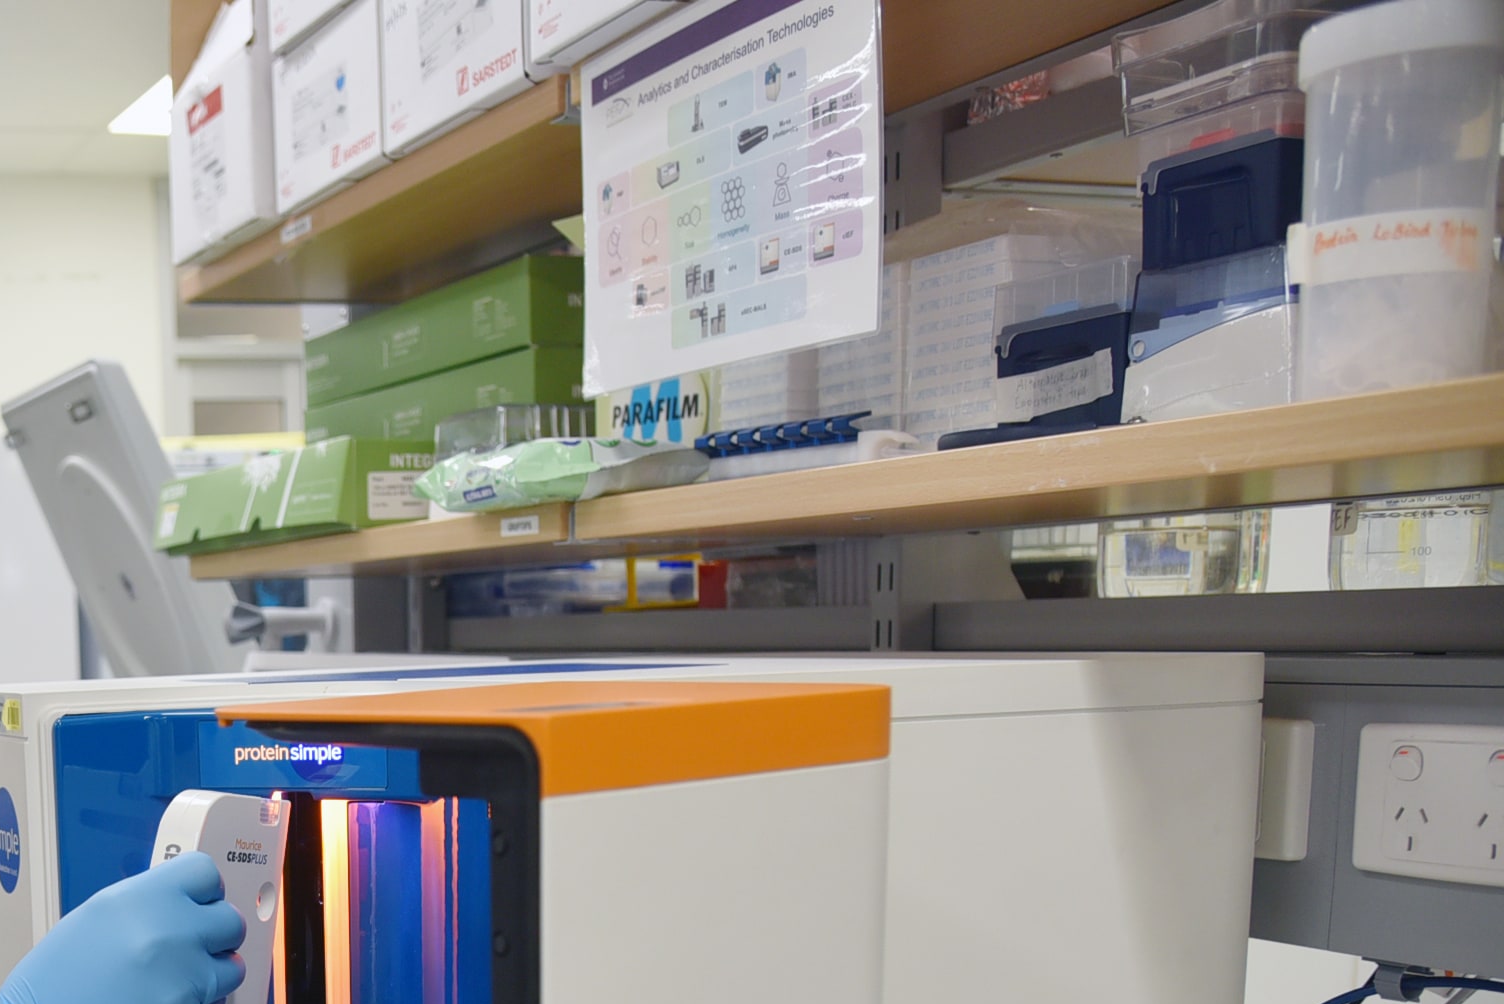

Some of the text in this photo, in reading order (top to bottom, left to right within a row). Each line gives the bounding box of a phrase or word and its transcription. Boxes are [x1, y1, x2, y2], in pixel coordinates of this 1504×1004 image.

[637, 78, 672, 107] Analytics
[674, 69, 690, 89] and
[691, 37, 764, 80] Characterisation
[767, 5, 834, 44] Technologies
[472, 48, 517, 87] SARSTEDT
[612, 394, 699, 428] PARAFILM
[389, 452, 436, 468] INTEG
[1410, 546, 1432, 556] 100
[235, 744, 342, 765] proteinsimple
[235, 838, 263, 851] Maurice
